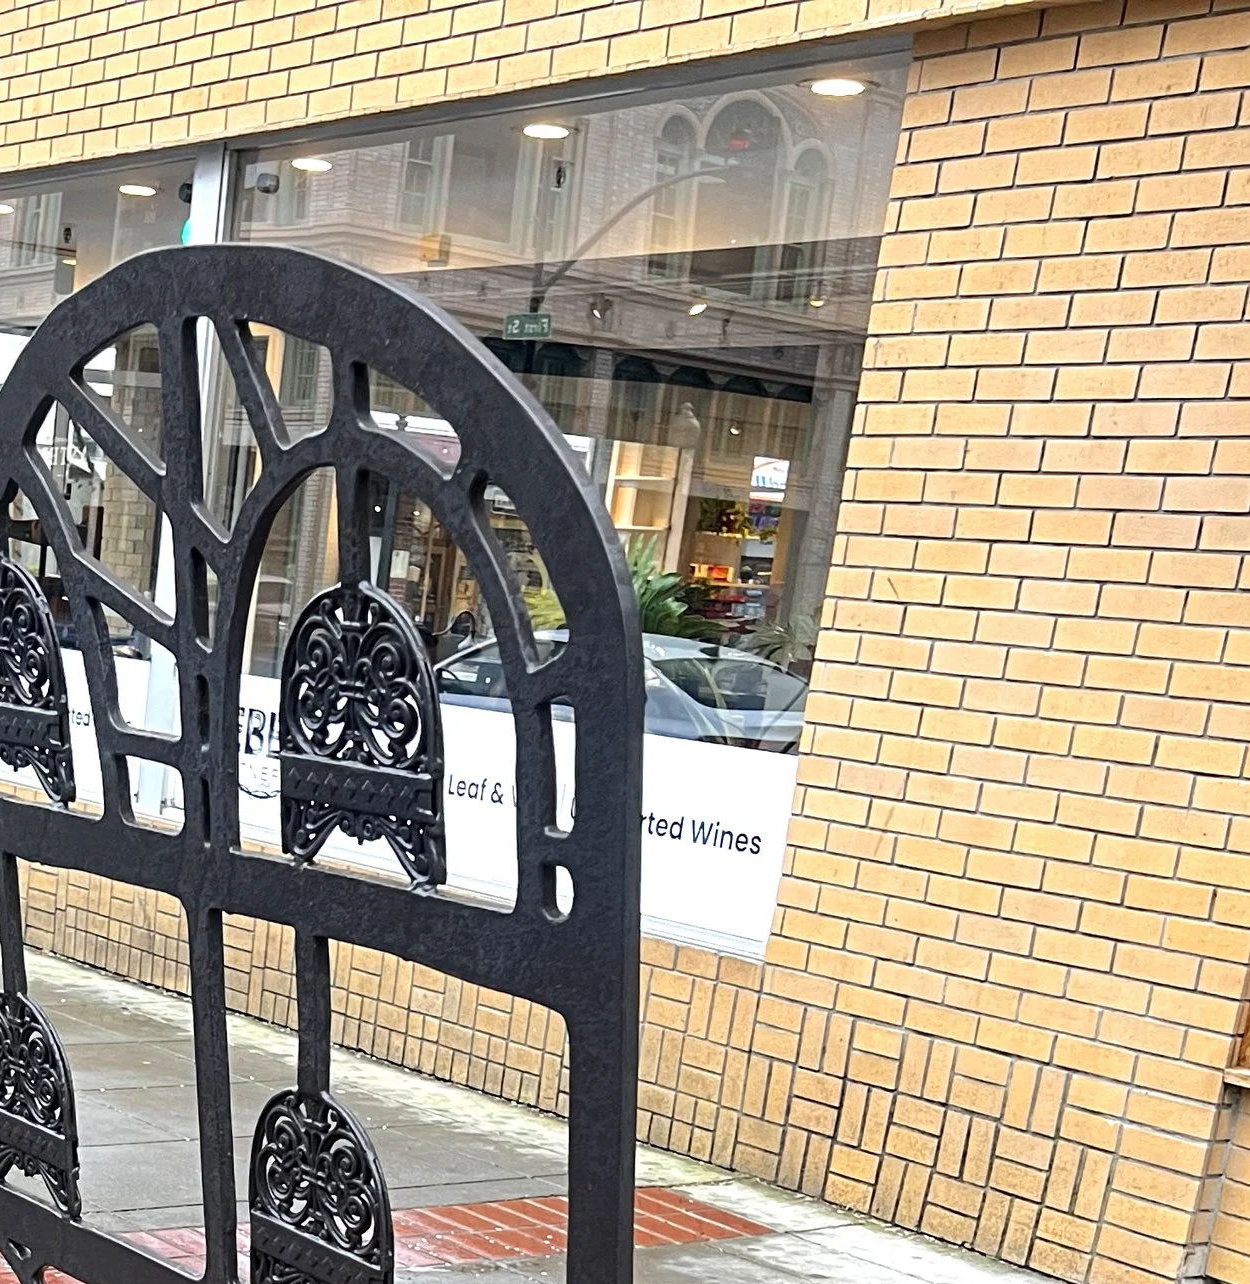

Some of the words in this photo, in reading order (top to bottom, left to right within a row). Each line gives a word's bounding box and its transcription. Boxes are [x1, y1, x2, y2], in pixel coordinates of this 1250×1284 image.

[448, 774, 488, 801] Leaf
[490, 782, 504, 804] &
[691, 819, 762, 855] Wines
